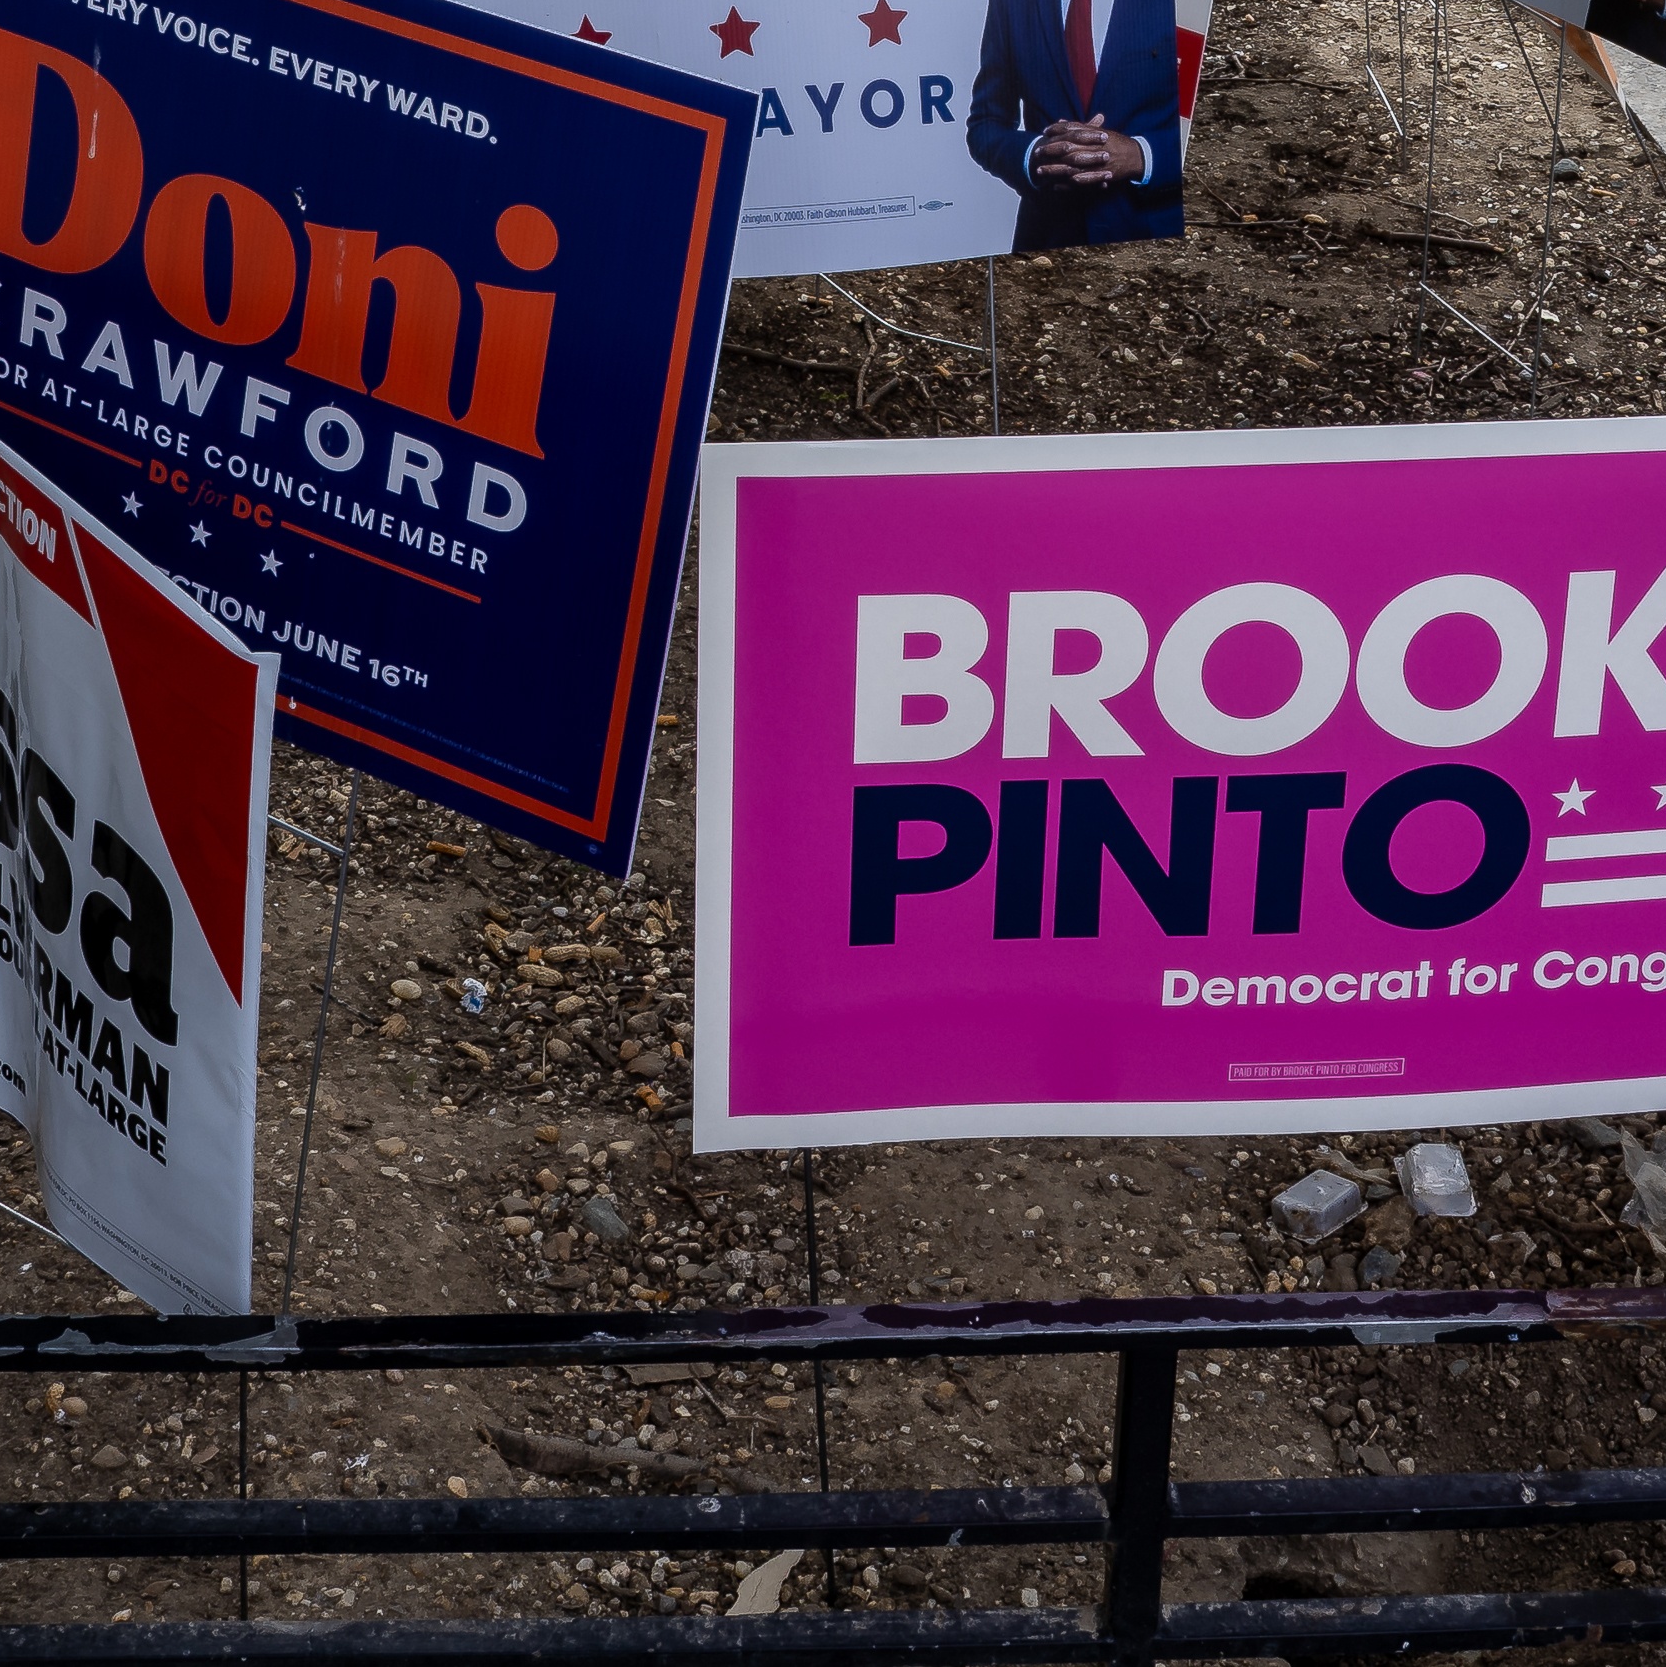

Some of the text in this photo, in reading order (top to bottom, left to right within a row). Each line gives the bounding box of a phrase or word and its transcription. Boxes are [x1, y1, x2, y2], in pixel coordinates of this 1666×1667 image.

[151, 8, 261, 68] VOICE.
[267, 45, 381, 108] EVERY
[383, 82, 500, 146] WARD.
[39, 376, 191, 458] AT-LARGE
[202, 443, 490, 576] COUNCILMEMBER
[148, 458, 274, 529] DC DC
[272, 620, 361, 673] JUNE
[847, 761, 1532, 947] PINTO
[1160, 960, 1435, 1008] Democrat
[1447, 953, 1519, 996] for
[1233, 1060, 1400, 1078] PAID FOR BY BROOKE PINTO FOR CONGRESS
